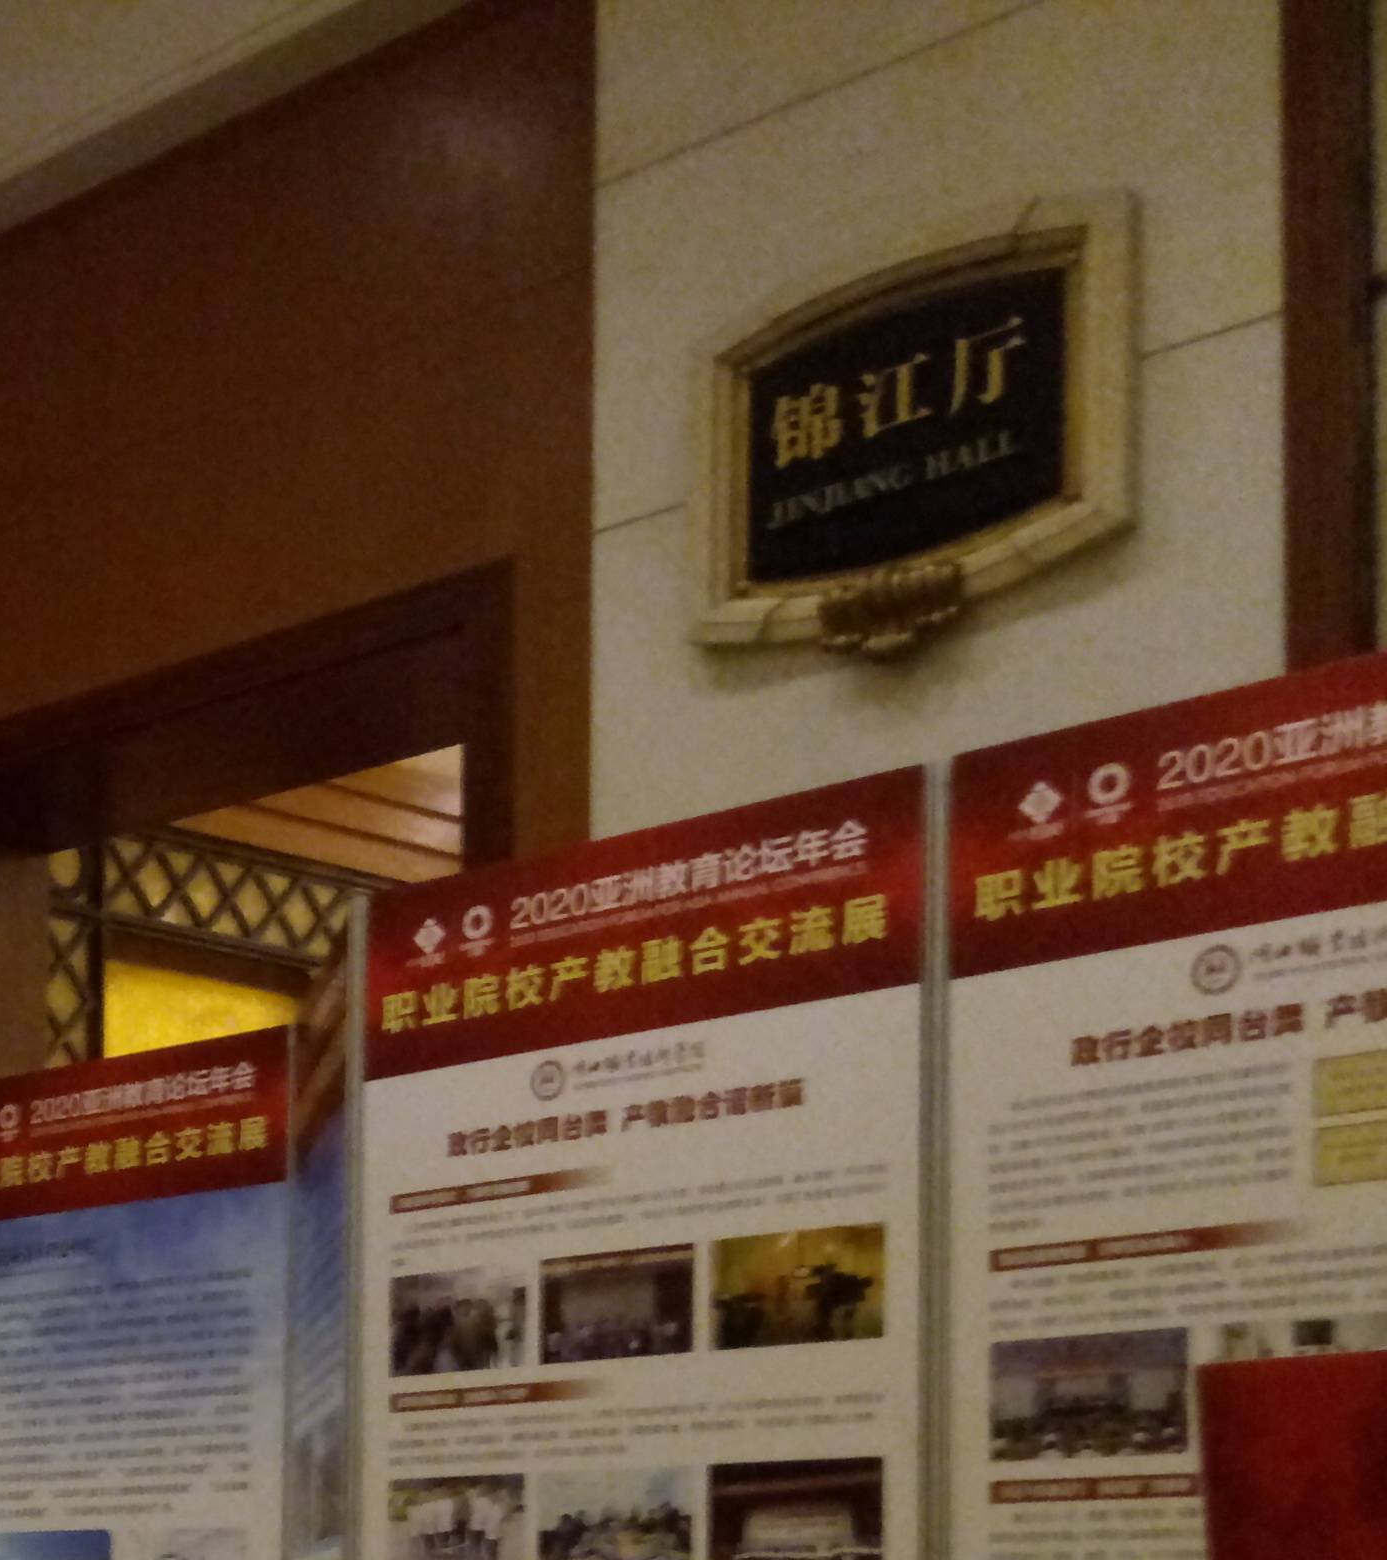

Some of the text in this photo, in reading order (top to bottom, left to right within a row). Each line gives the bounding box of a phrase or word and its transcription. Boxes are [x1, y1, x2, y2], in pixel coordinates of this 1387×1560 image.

[772, 315, 1026, 470] 锦江厅
[926, 429, 1025, 480] HALL
[510, 820, 868, 931] 2020亚洲教育论坛年会
[381, 894, 888, 1035] 职业院校产教融合交流展
